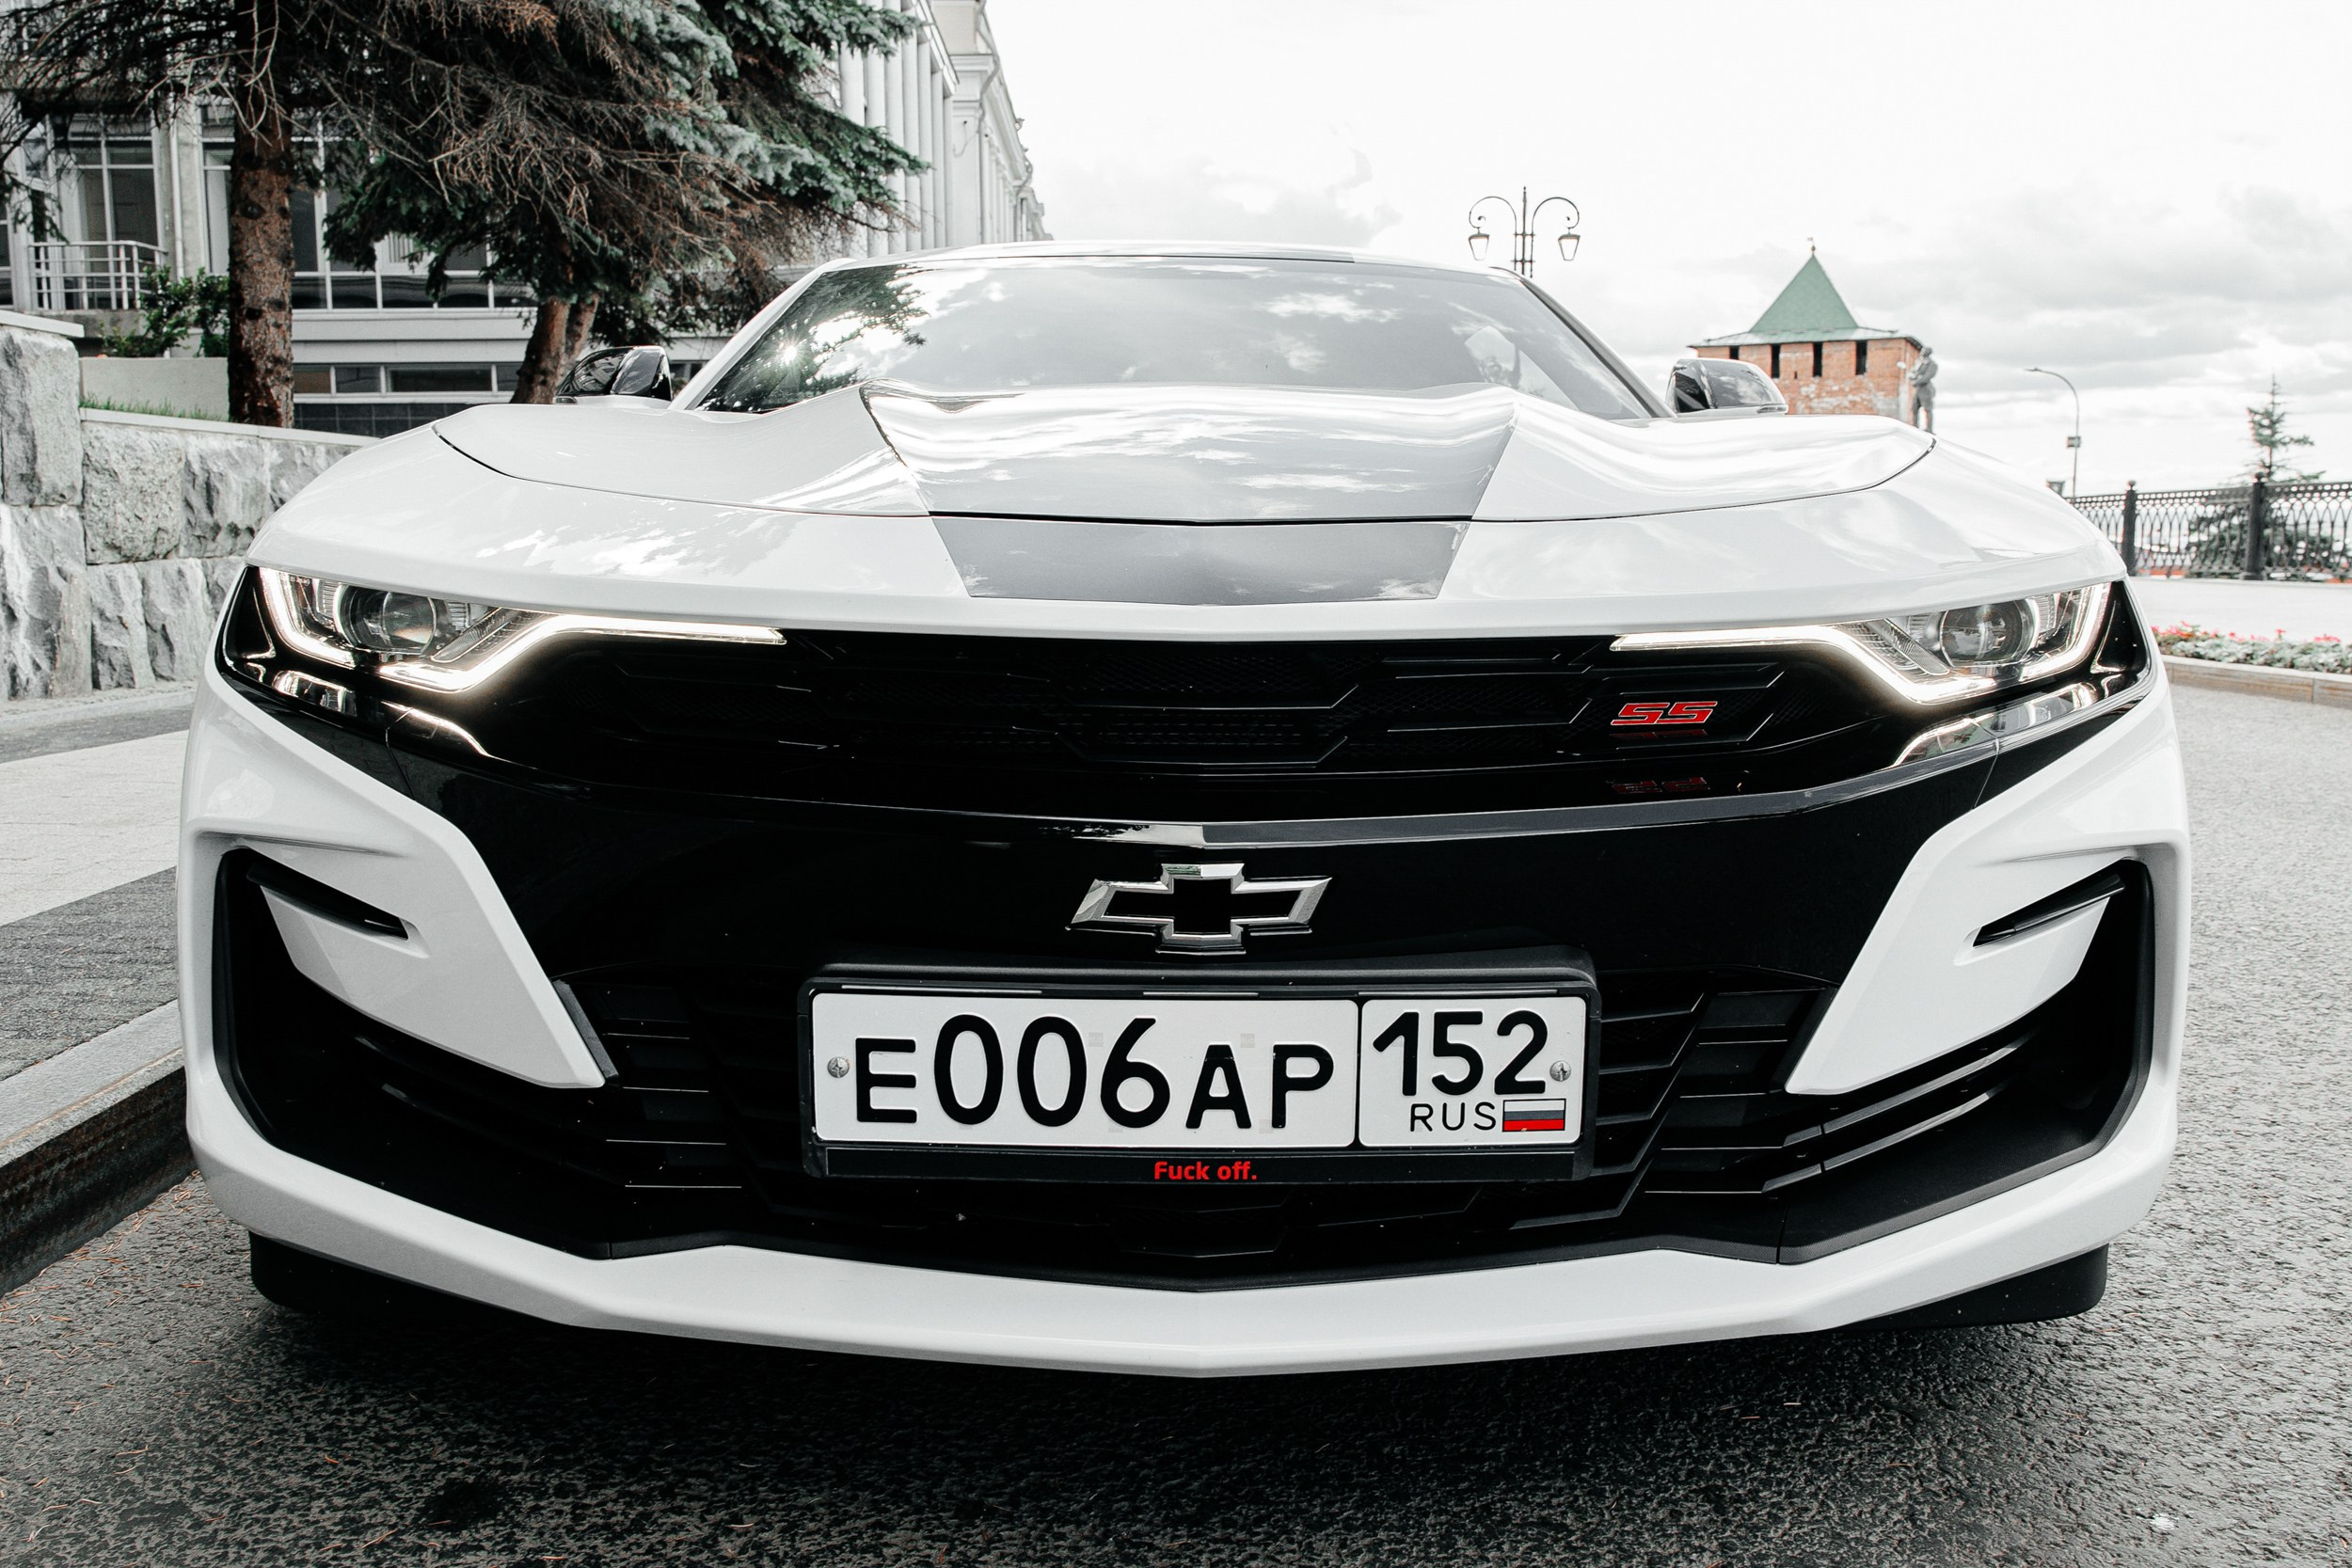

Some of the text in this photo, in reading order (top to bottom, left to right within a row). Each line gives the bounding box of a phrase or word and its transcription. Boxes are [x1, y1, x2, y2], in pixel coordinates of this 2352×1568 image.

[1610, 700, 1719, 726] SS
[854, 1009, 1549, 1130] E006AP 152
[1409, 1101, 1497, 1132] RUS
[1153, 1160, 1258, 1180] Fuck off.
